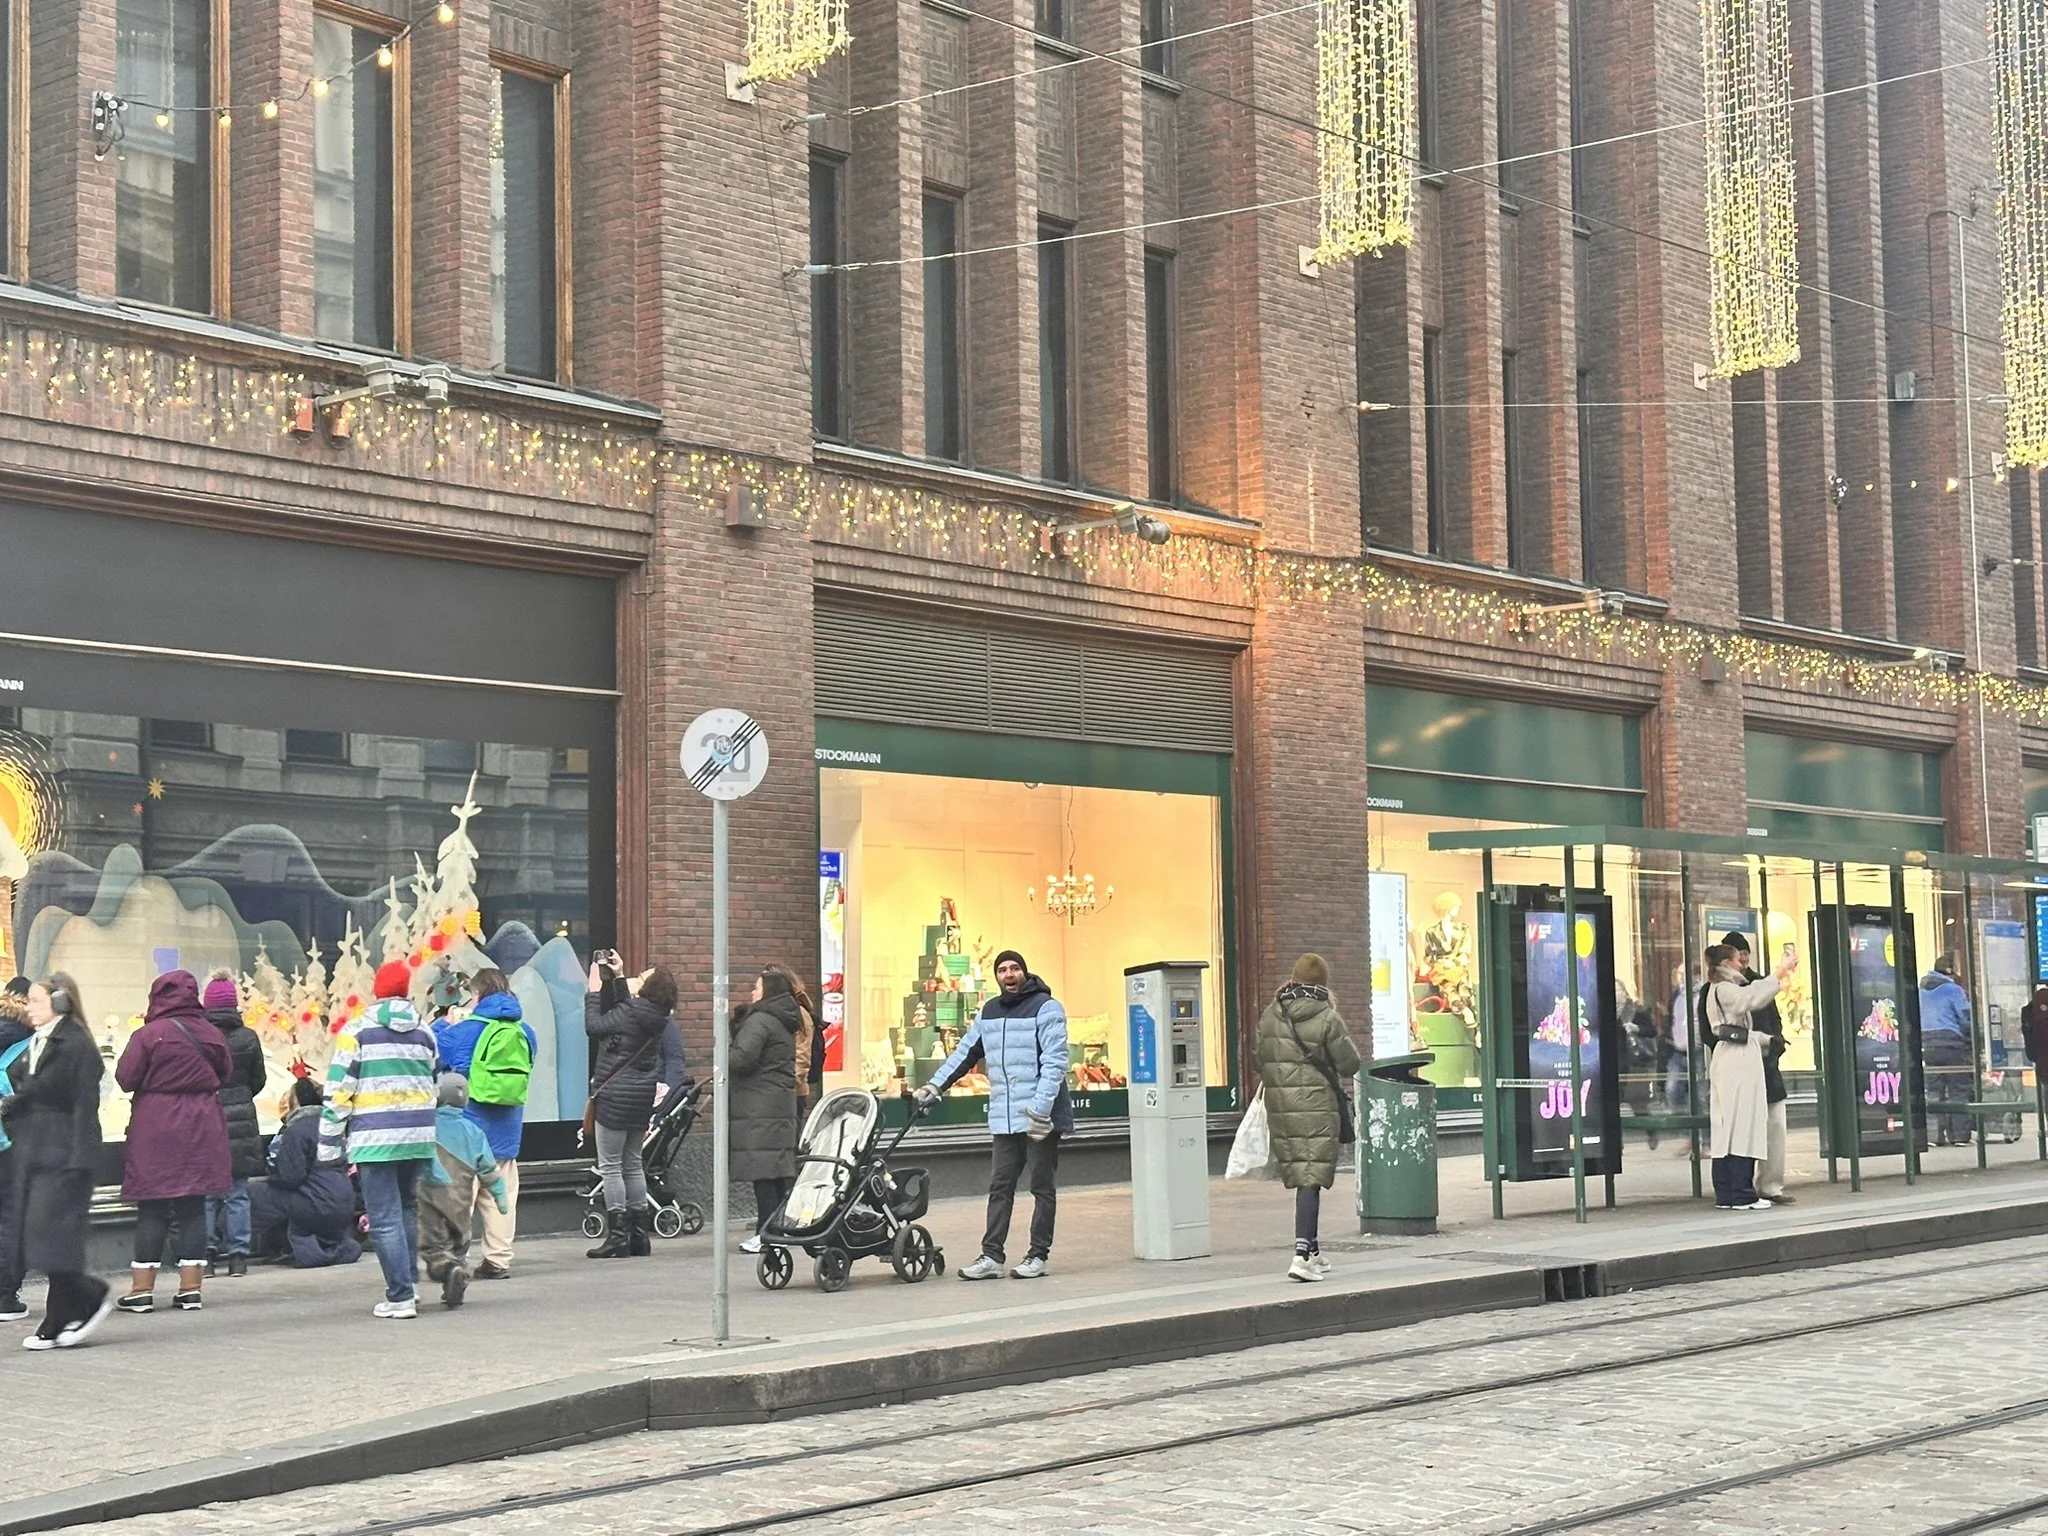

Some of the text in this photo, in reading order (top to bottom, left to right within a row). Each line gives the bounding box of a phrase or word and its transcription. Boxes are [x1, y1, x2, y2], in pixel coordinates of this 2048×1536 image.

[814, 748, 881, 764] STOCKMANN
[1540, 1079, 1592, 1118] JOY
[1864, 1071, 1902, 1105] JOY
